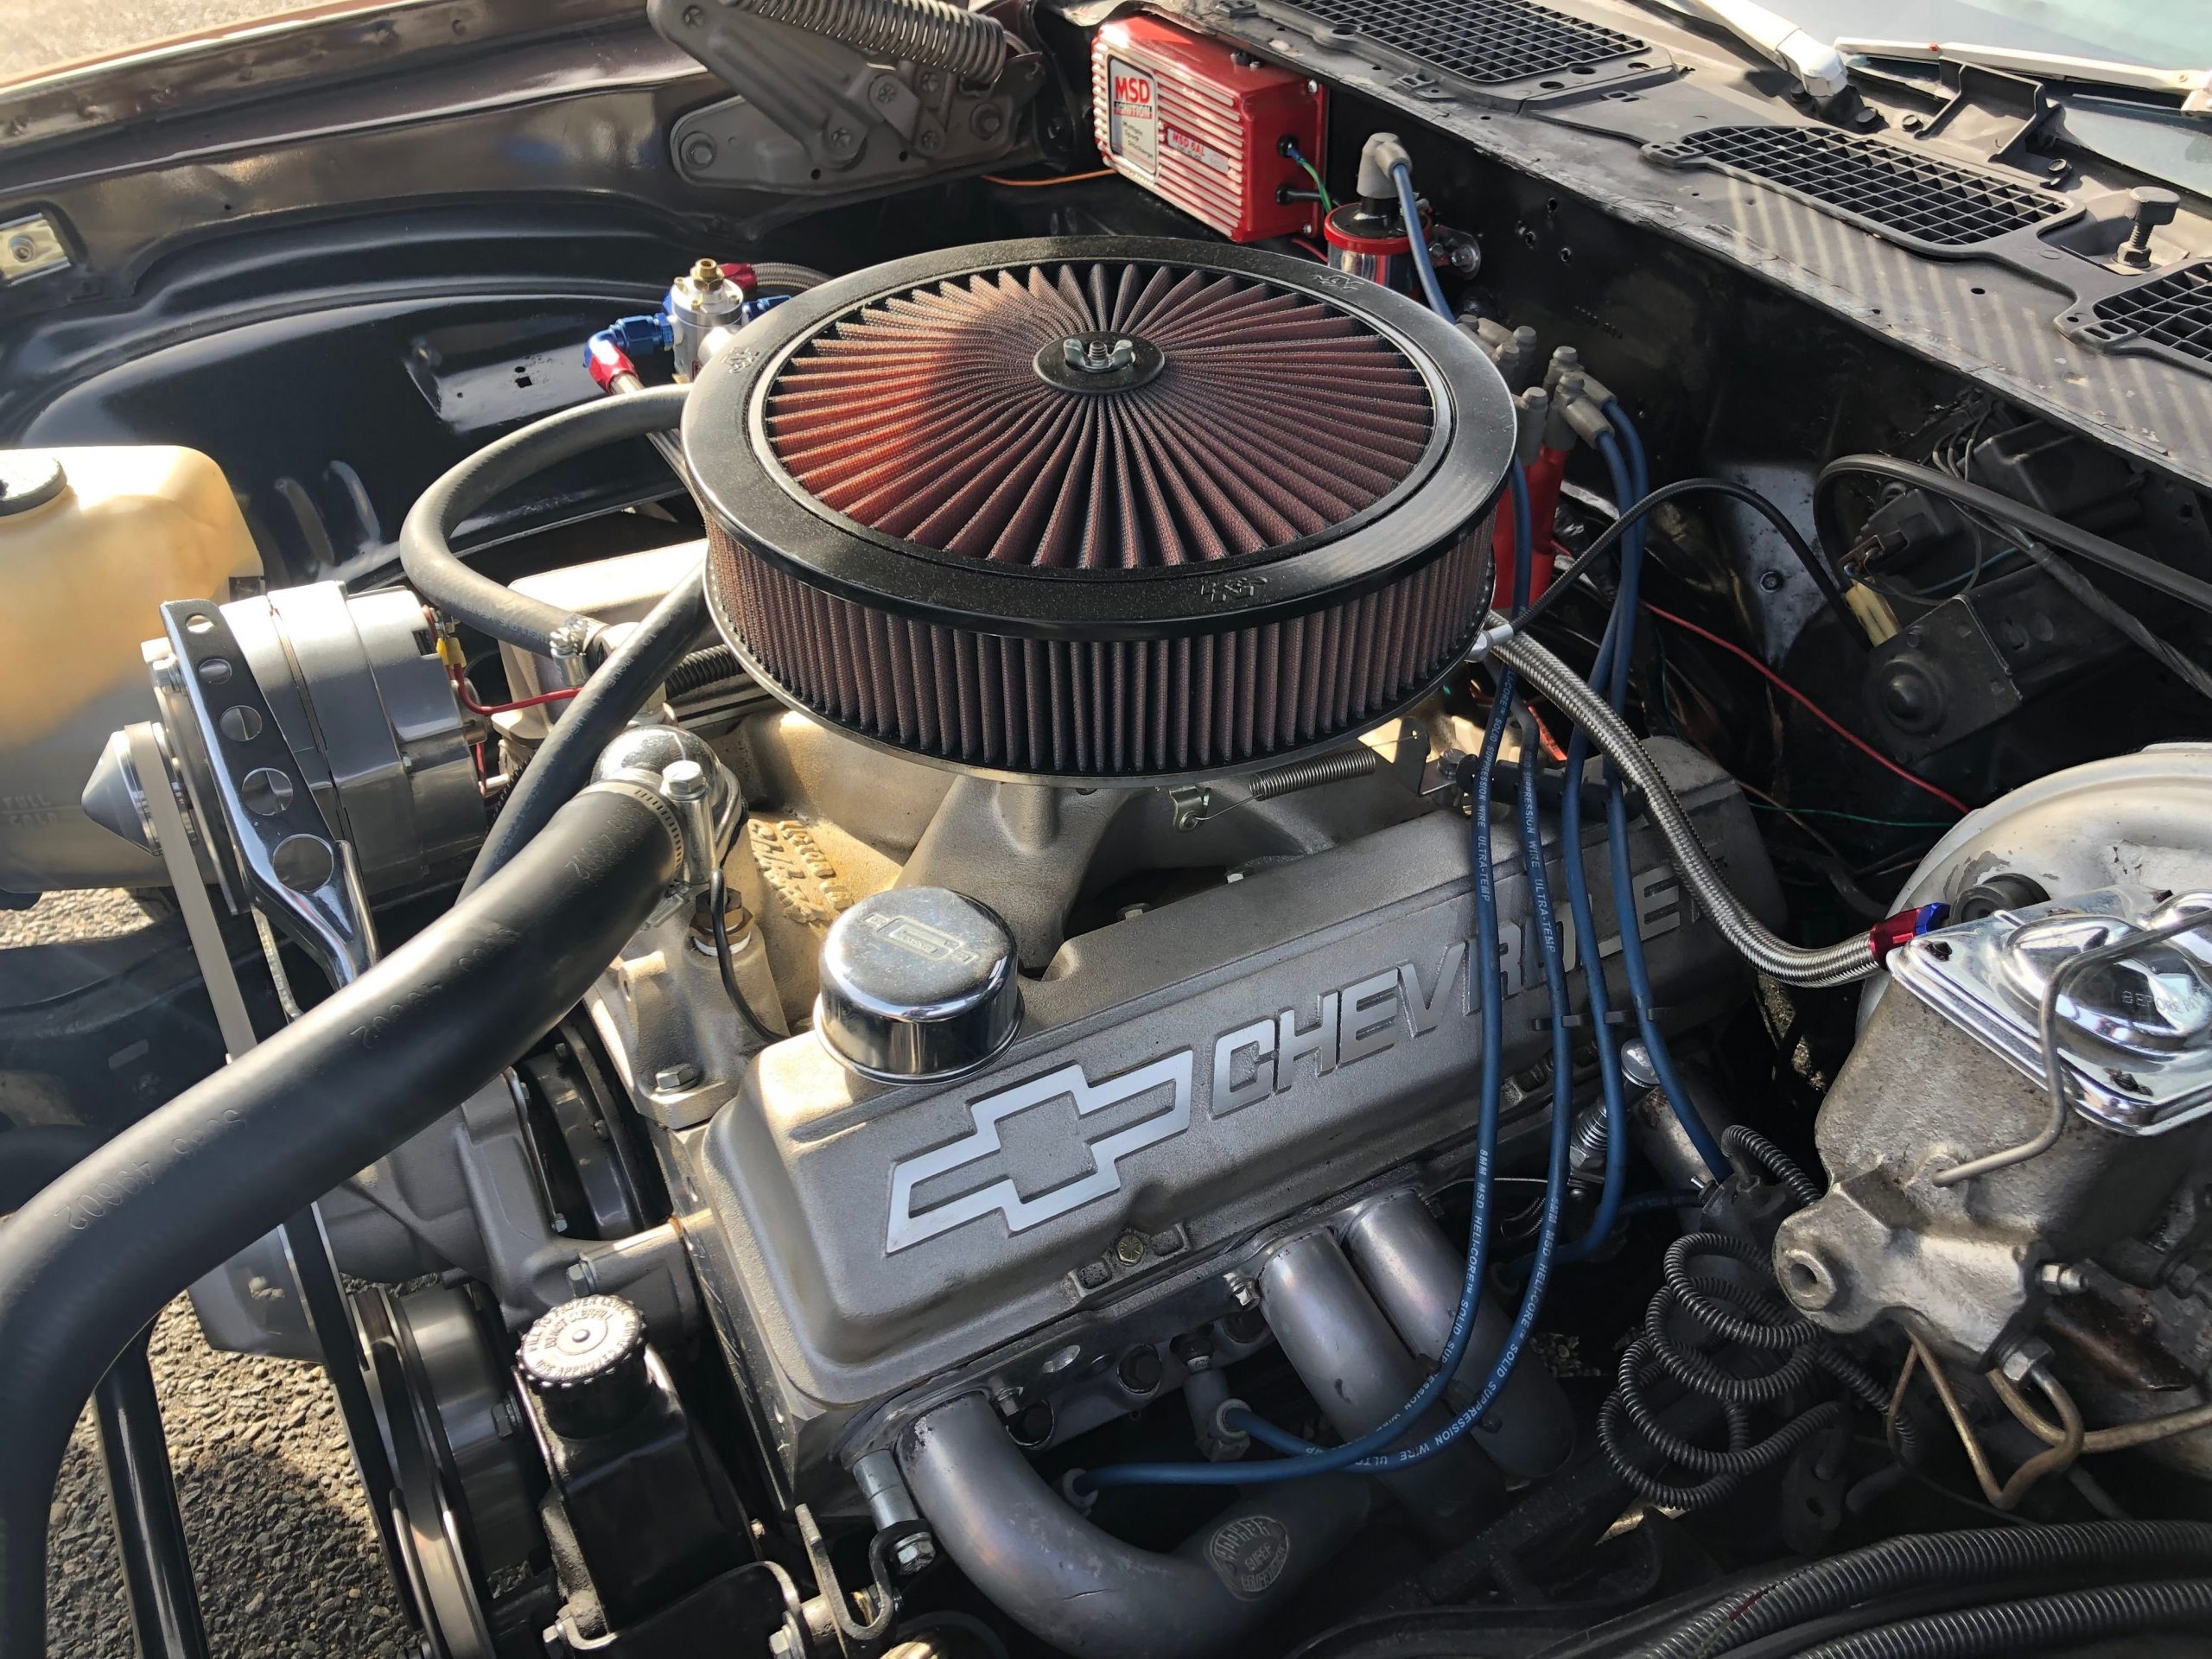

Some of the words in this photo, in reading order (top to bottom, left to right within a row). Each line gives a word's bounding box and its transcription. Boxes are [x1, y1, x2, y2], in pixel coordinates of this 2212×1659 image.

[1115, 76, 1151, 104] MSD
[1476, 744, 1496, 803] SUPPRESSION
[1476, 804, 1486, 829] WIRE
[1522, 770, 1535, 835] SUPPRESSION
[1478, 836, 1491, 902] ULTRA-TEMP
[1528, 840, 1541, 868] WIRE
[1533, 878, 1556, 952] ULTRA-TEMP
[1211, 864, 1701, 1119] CHEVROE
[1478, 1148, 1488, 1176] 8MM
[1476, 1182, 1487, 1209] MSD
[1541, 1230, 1554, 1258] MSD
[1452, 1299, 1469, 1336] SOLID
[1496, 1342, 1519, 1380] SOLID
[1433, 1380, 1498, 1447] SUPPRESSION
[1399, 1443, 1430, 1463] WIRE
